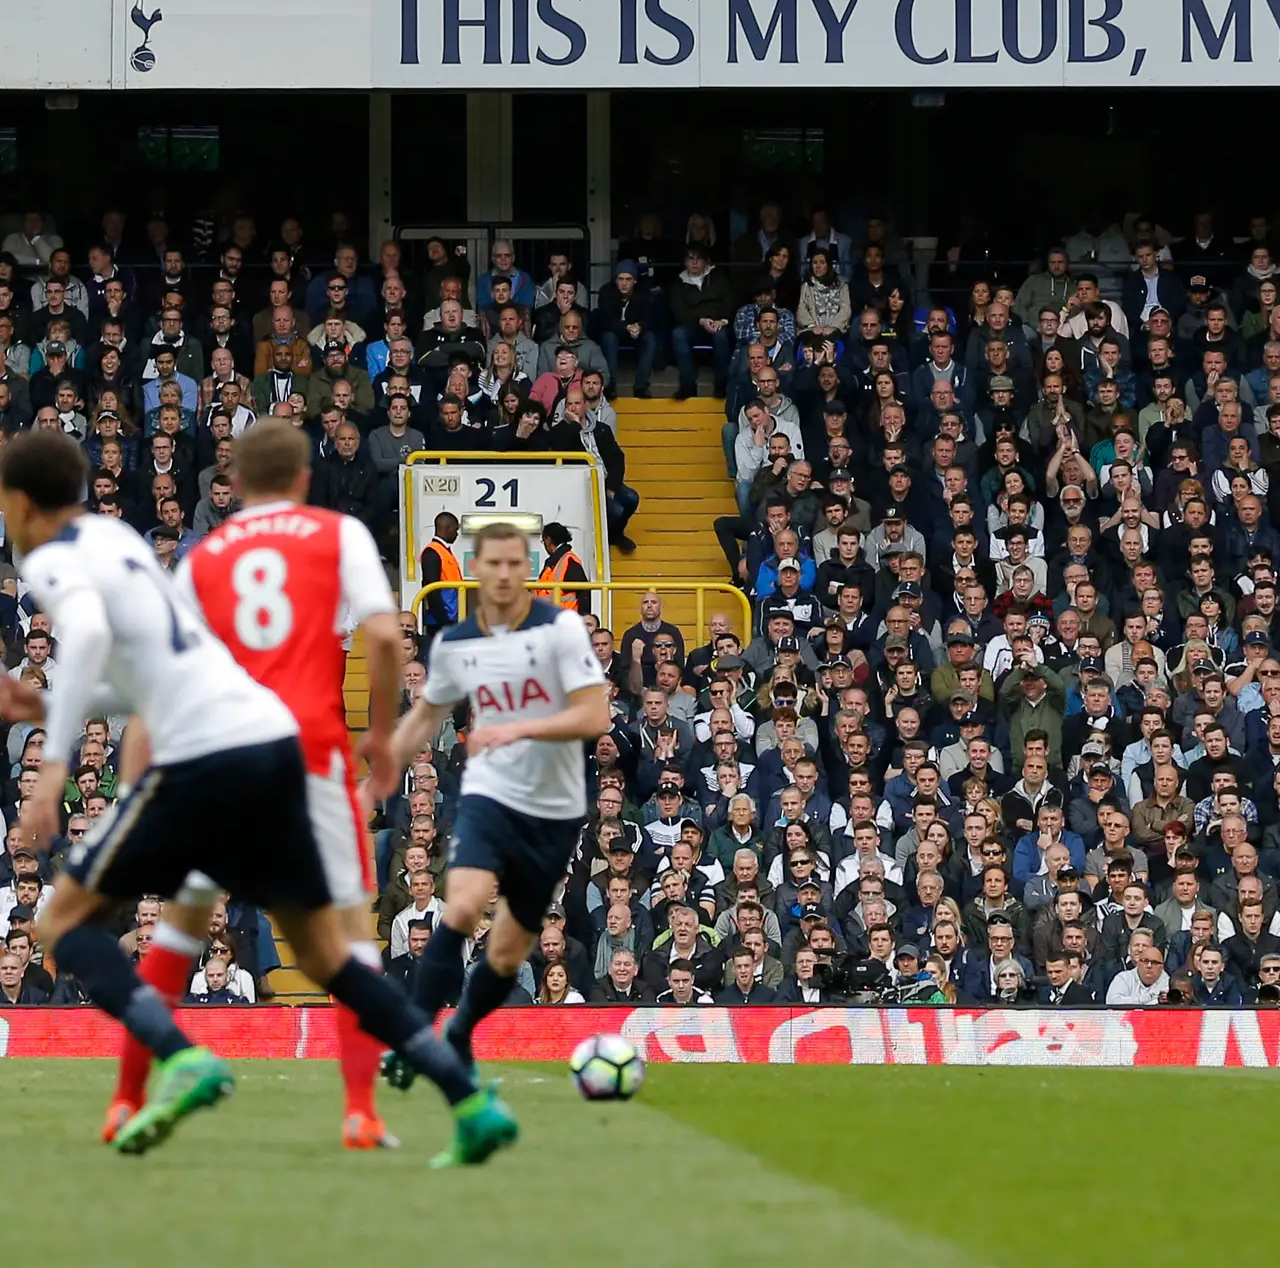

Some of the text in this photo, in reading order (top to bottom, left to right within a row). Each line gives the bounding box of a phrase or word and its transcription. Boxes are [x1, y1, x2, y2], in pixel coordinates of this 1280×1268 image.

[474, 477, 519, 507] 21
[232, 547, 294, 652] 8
[476, 678, 552, 714] AIA
